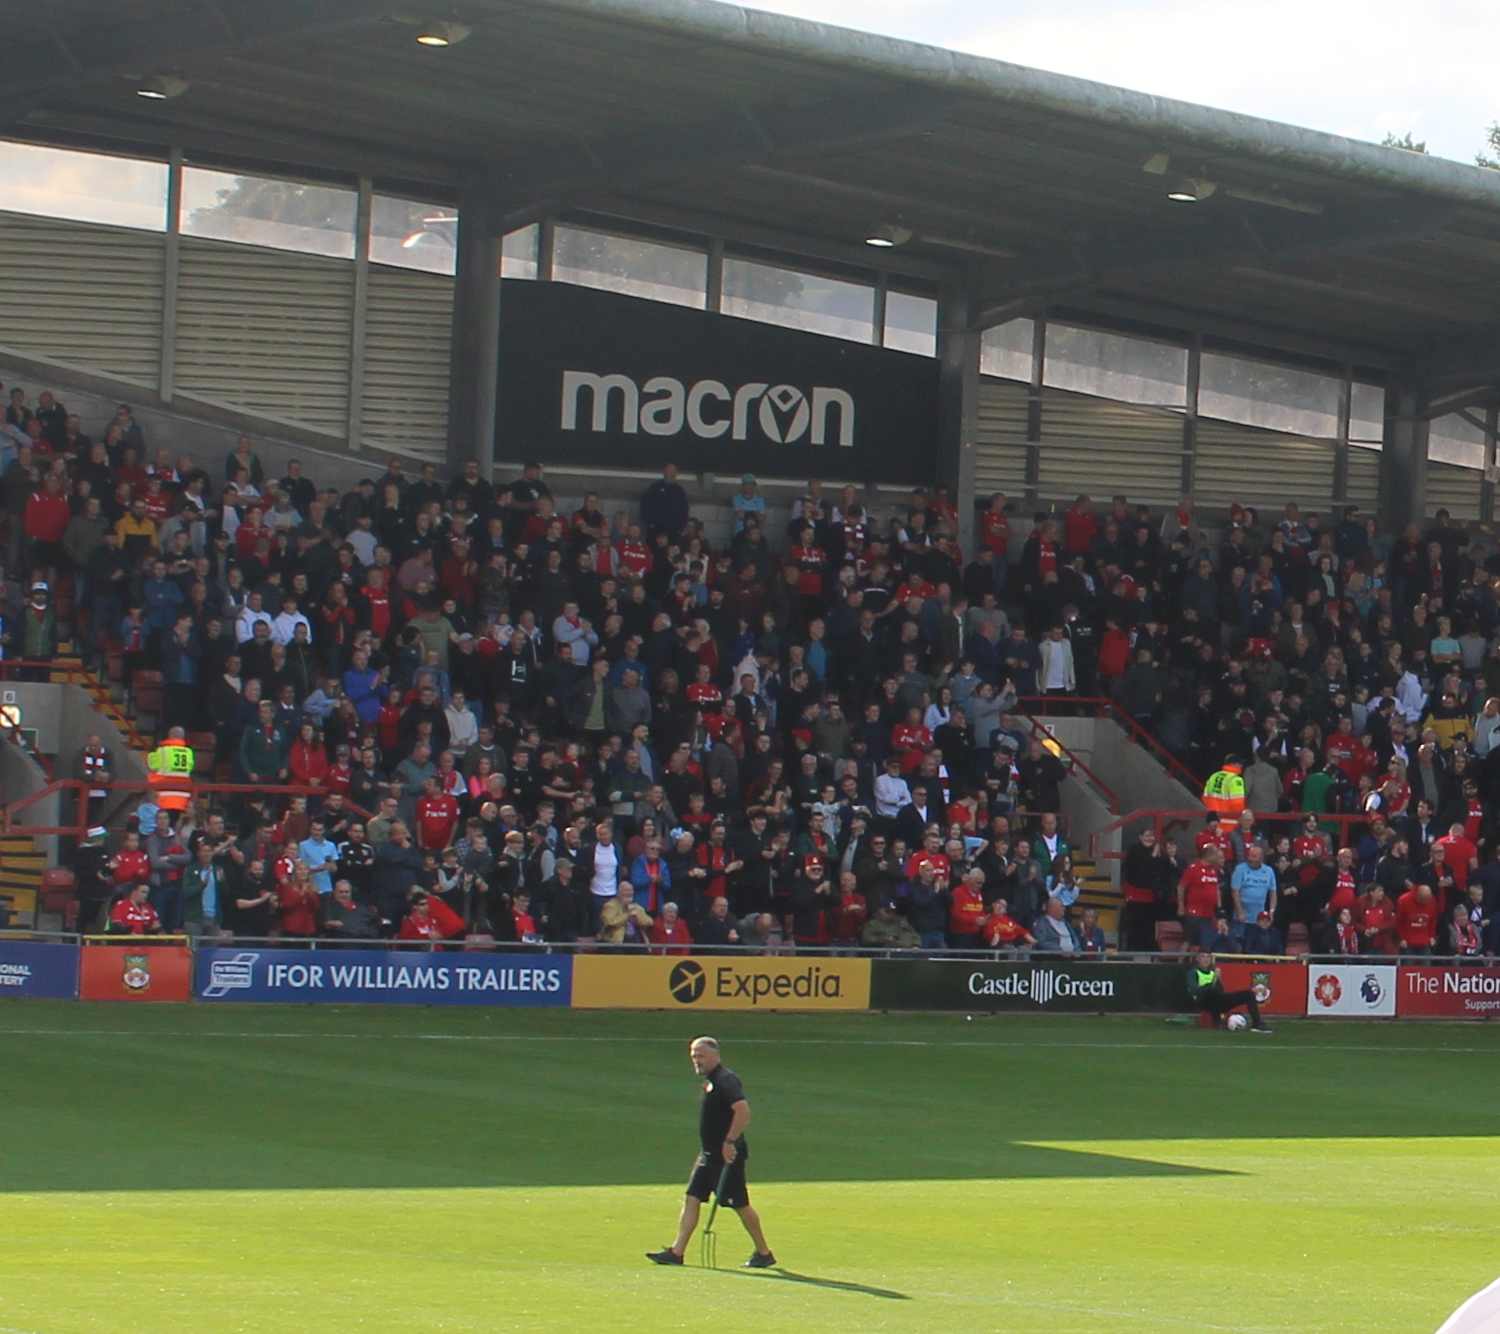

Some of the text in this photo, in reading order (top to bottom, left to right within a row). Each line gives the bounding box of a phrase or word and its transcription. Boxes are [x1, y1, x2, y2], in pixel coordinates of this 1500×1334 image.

[561, 370, 854, 447] macron
[267, 964, 561, 992] IFOR WILLIAMS TRAILERS
[716, 965, 841, 1001] Expedia
[968, 971, 1114, 998] Castle Green
[1406, 972, 1440, 994] The
